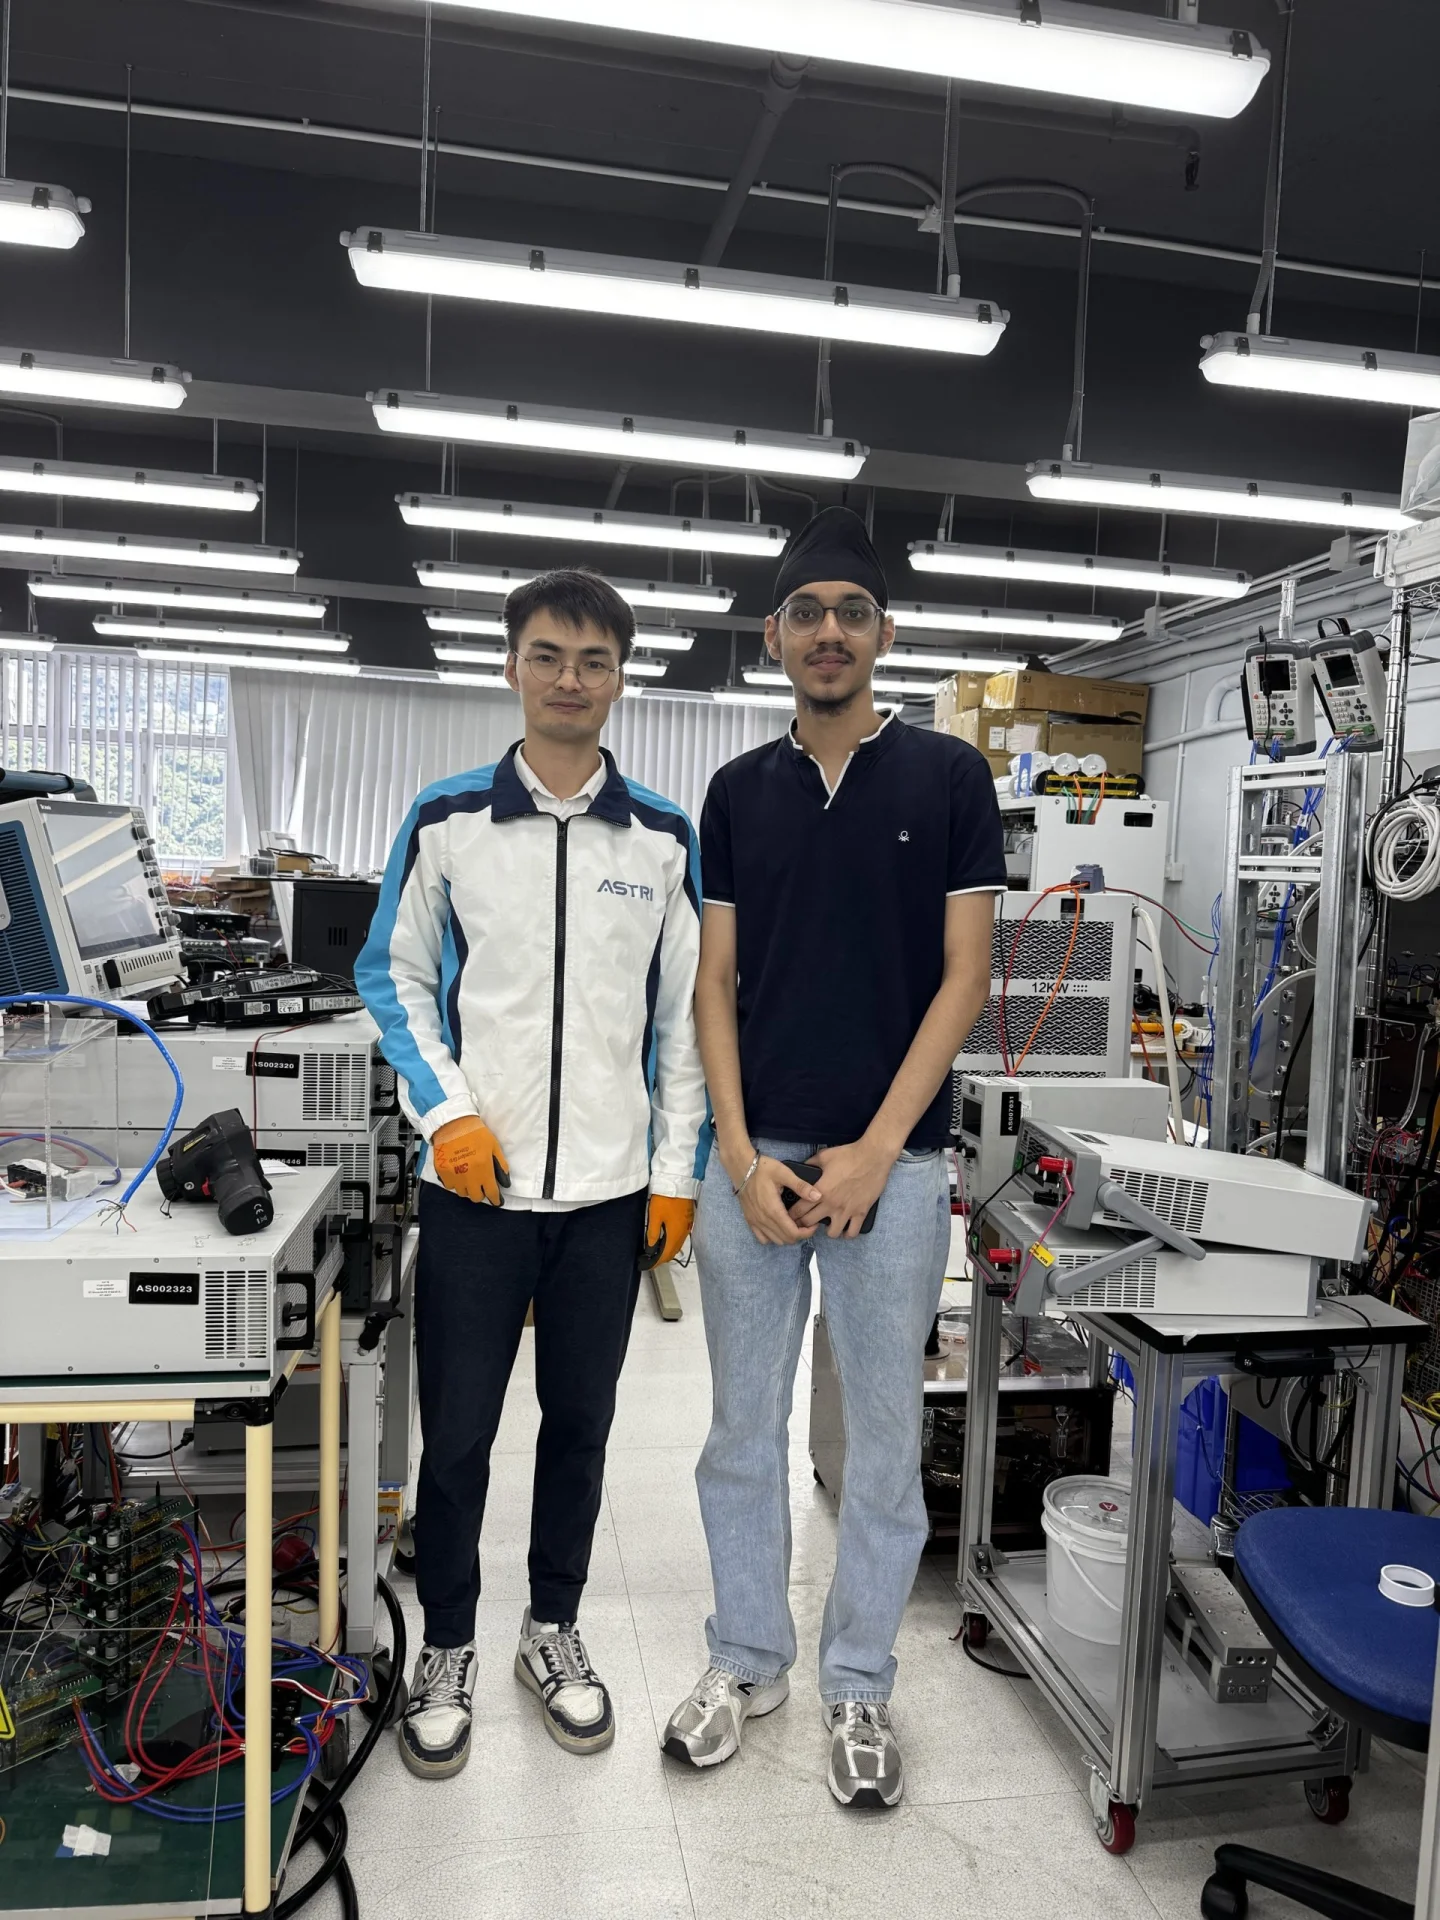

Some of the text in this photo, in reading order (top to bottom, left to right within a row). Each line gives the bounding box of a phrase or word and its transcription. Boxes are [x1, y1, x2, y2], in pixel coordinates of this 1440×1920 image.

[597, 879, 654, 901] ASTRI
[1032, 981, 1069, 994] 12KW
[454, 1162, 469, 1174] 3M
[136, 1285, 193, 1293] AS002323
